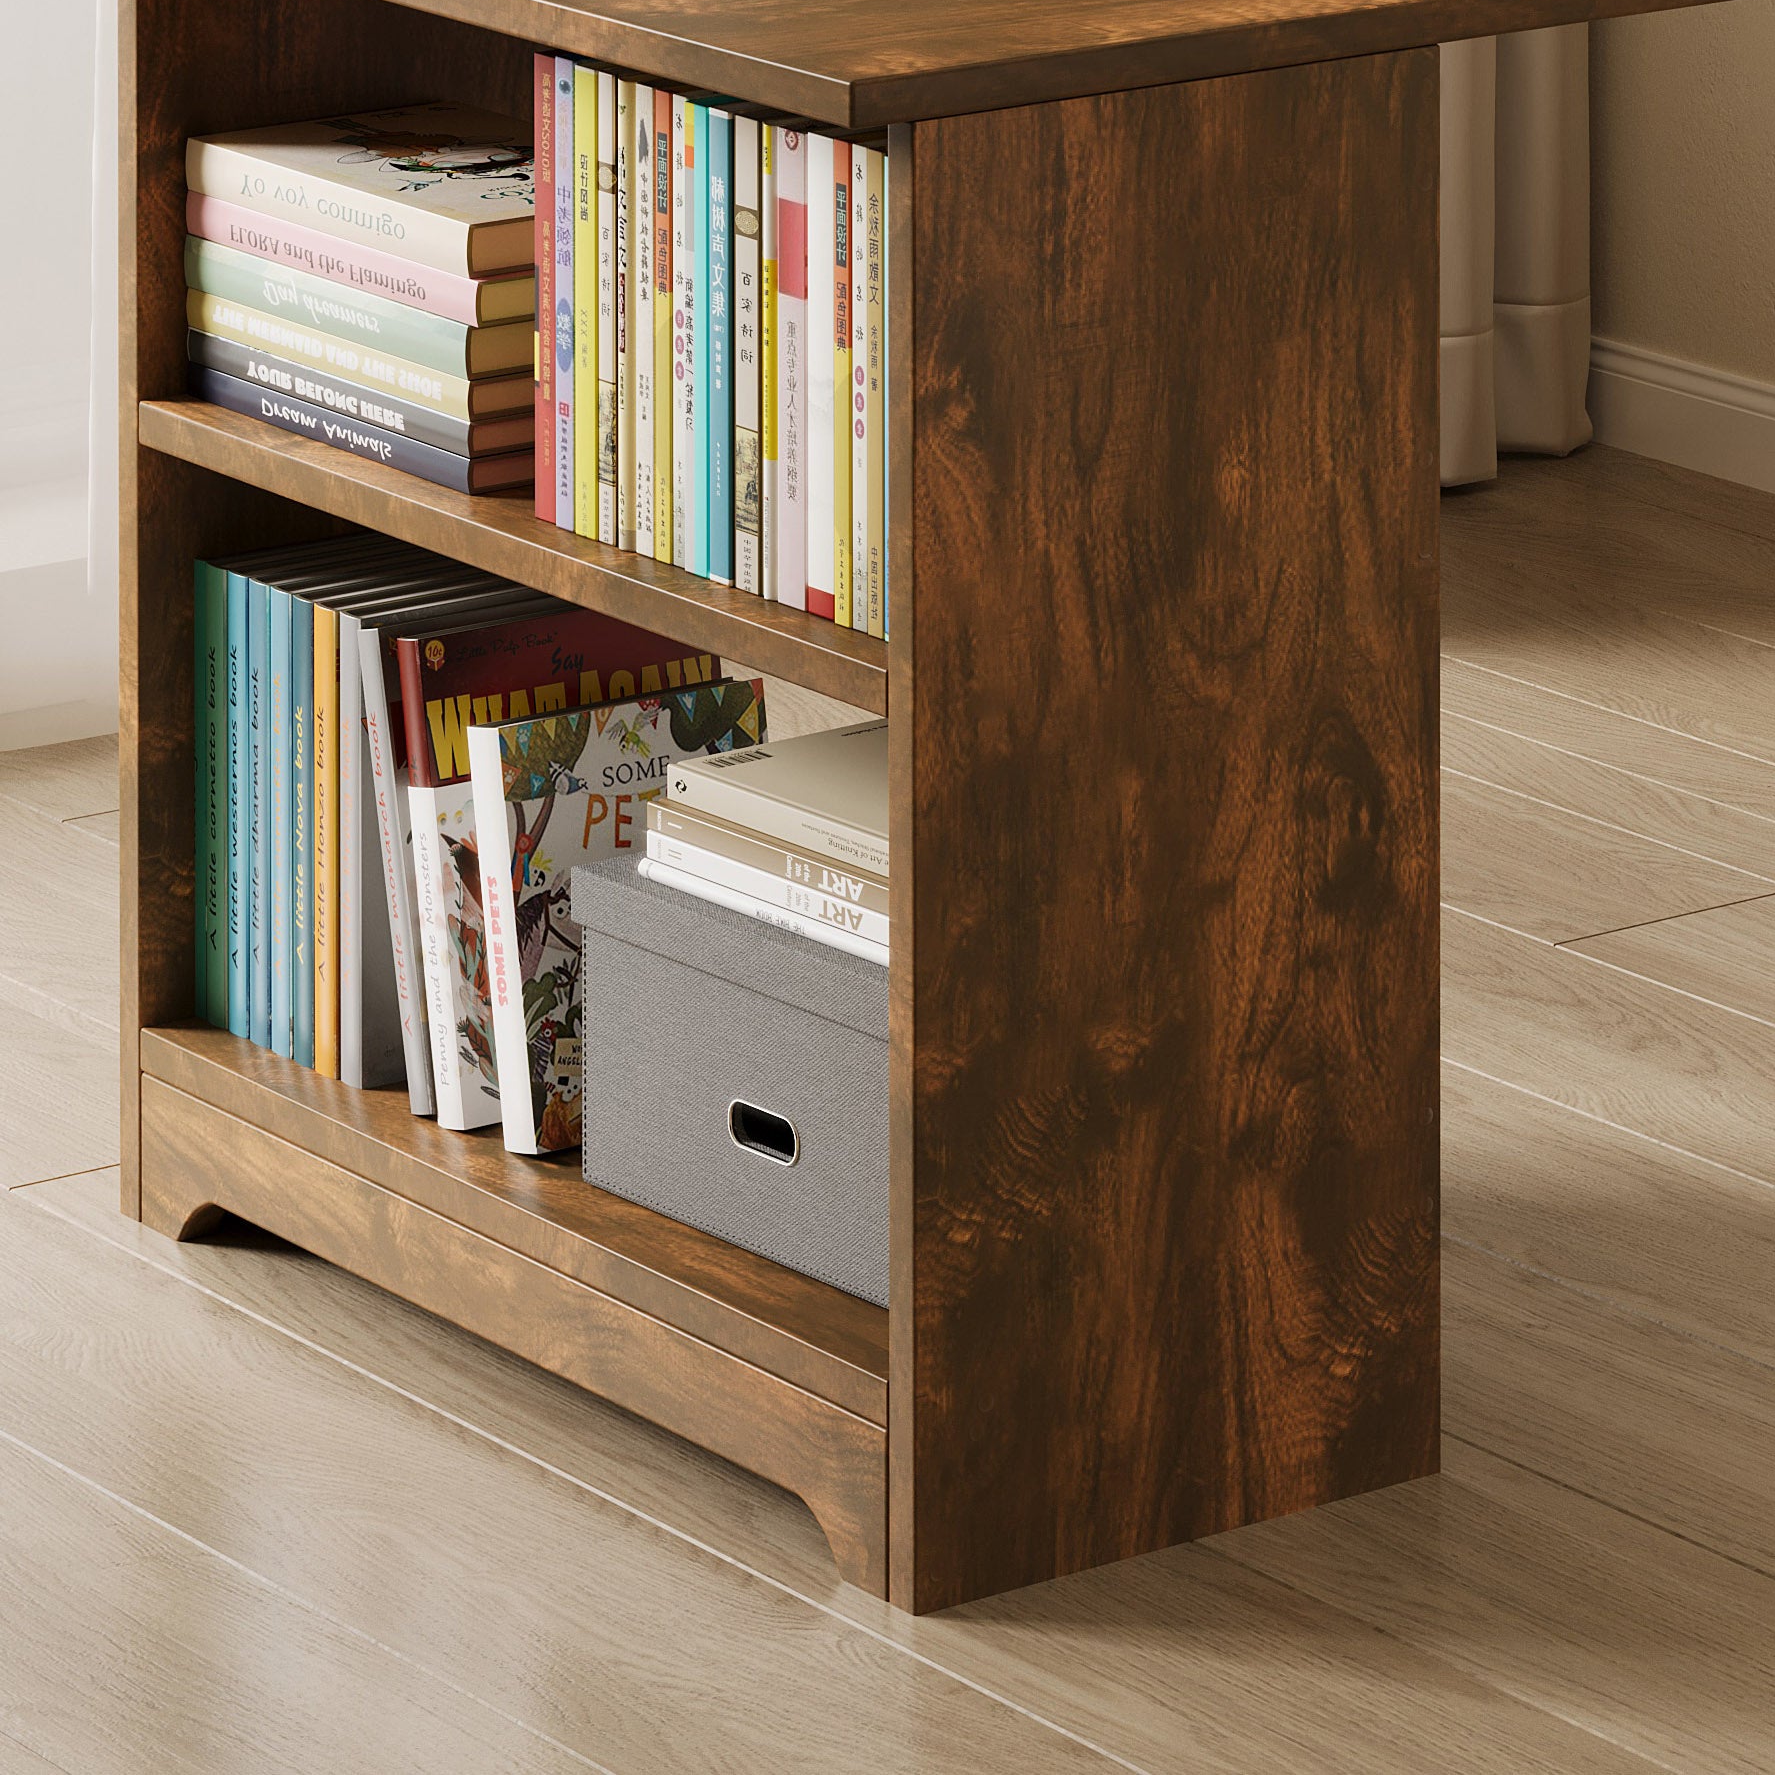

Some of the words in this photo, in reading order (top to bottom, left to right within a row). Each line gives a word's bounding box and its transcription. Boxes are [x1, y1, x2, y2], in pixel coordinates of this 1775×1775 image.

[208, 645, 216, 709] book
[230, 643, 238, 707] book
[551, 647, 585, 675] Say
[295, 704, 304, 769] book
[317, 705, 325, 770] book
[369, 711, 383, 776] book
[252, 744, 260, 853] dharma
[602, 755, 670, 787] SOME
[295, 782, 304, 852] Nova
[317, 782, 325, 869] Honzo
[828, 837, 859, 858] Knitting
[208, 856, 217, 916] little
[376, 790, 400, 919] monarch
[420, 832, 435, 925] Monsters
[818, 869, 864, 902] ART
[868, 853, 882, 866] Art
[231, 874, 239, 935] little
[252, 868, 260, 931] little
[296, 864, 304, 929] little
[487, 876, 503, 936] PETS
[818, 899, 864, 931] ART
[296, 943, 304, 965] A
[318, 960, 326, 982] A
[394, 932, 409, 999] little
[427, 934, 437, 970] the
[497, 942, 510, 1007] SOME
[402, 1015, 413, 1037] A
[430, 976, 444, 1015] and
[432, 1023, 449, 1086] Penny
